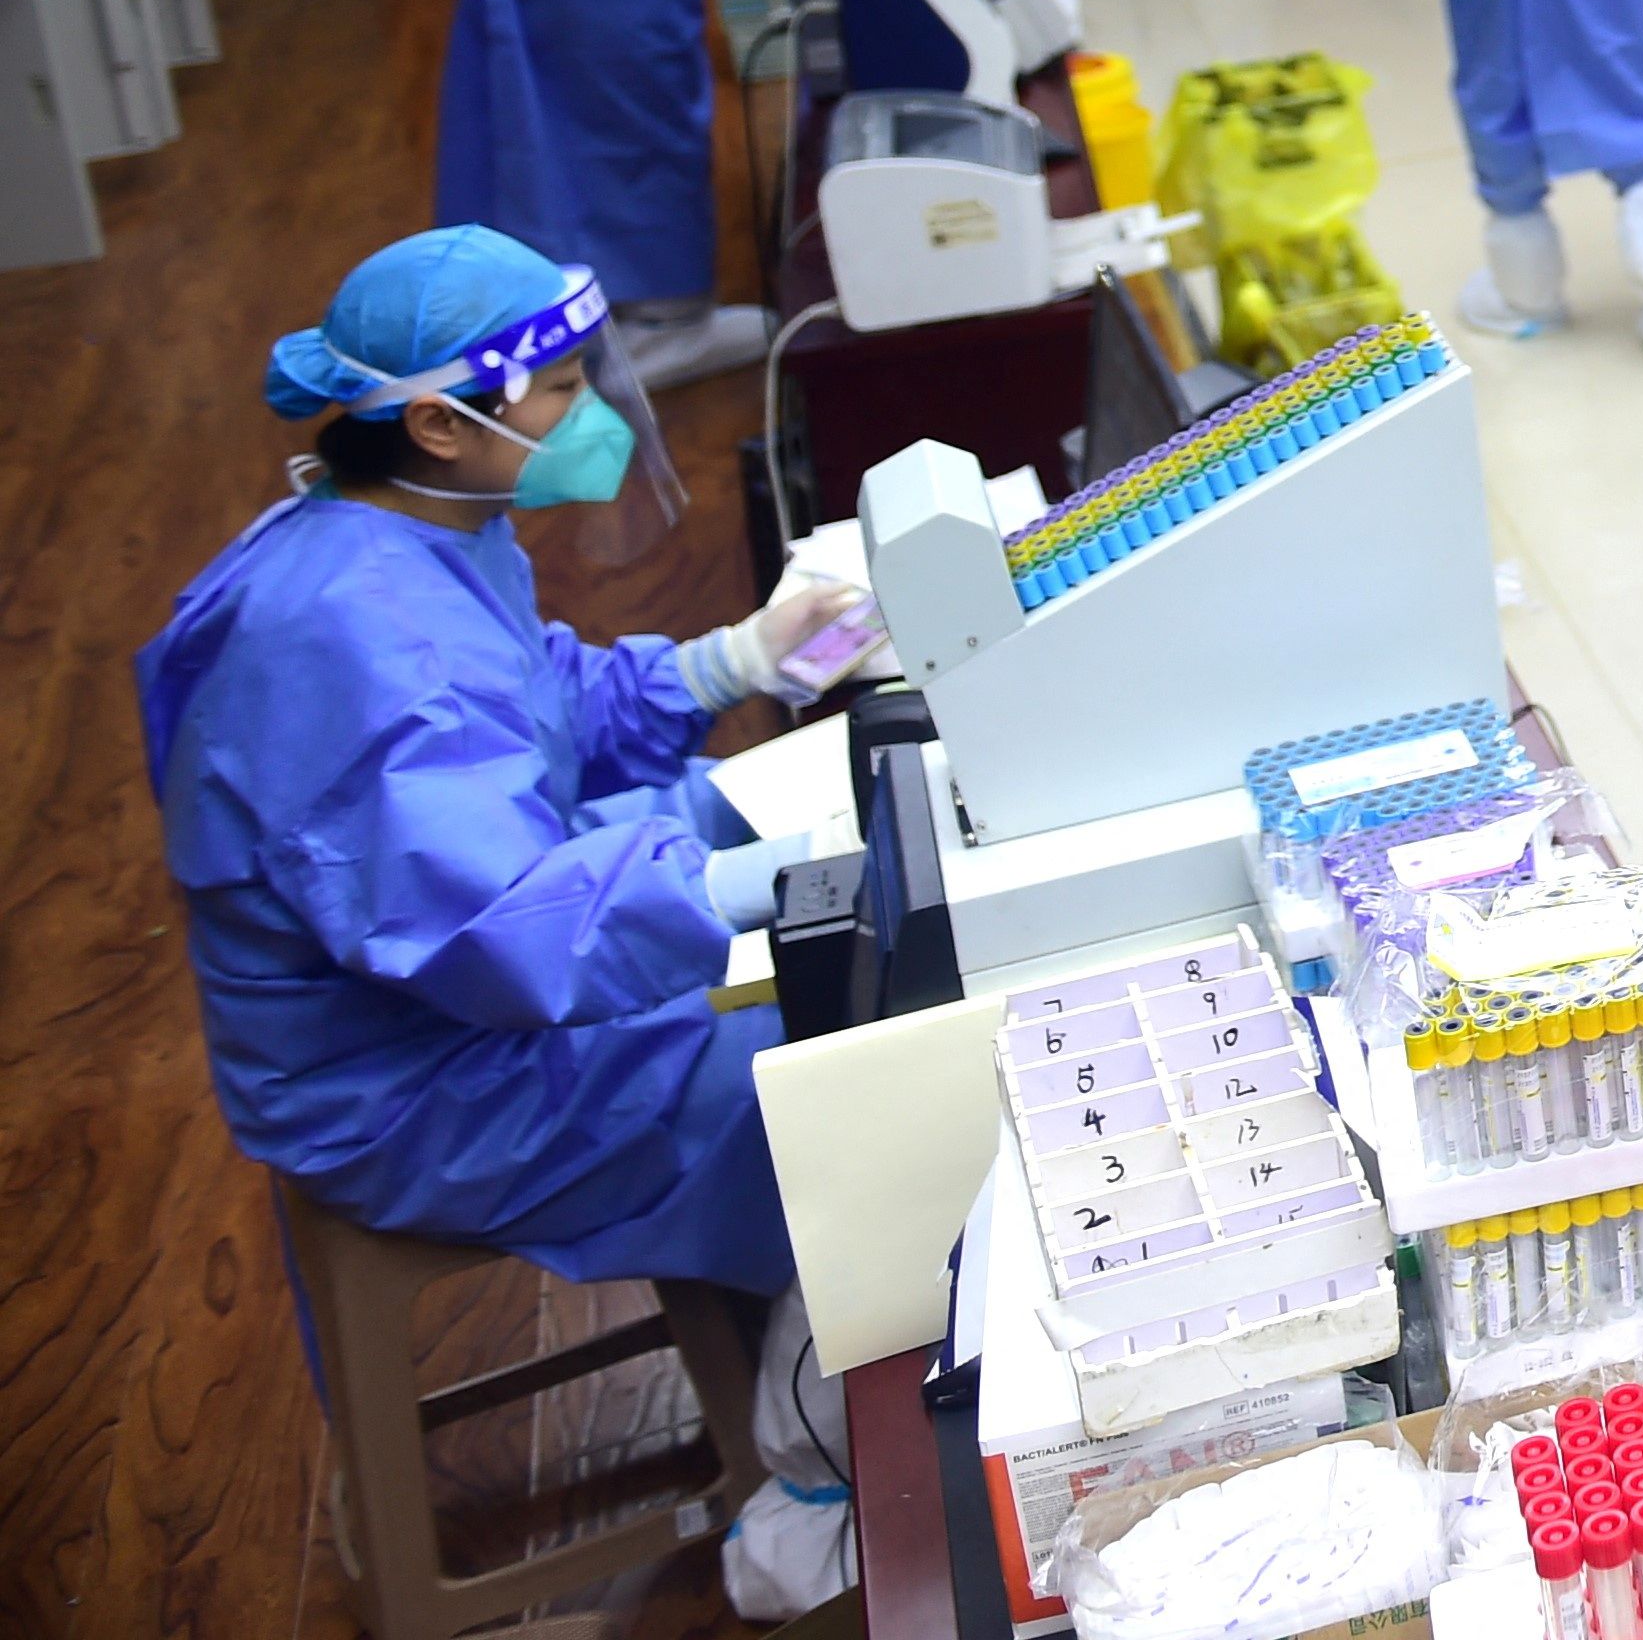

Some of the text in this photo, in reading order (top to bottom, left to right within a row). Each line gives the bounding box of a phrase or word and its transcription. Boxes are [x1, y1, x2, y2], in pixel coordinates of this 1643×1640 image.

[1184, 959, 1203, 983] 8
[1043, 998, 1063, 1013] 7
[1203, 991, 1217, 1015] 9
[1046, 1027, 1067, 1054] 6
[1212, 1027, 1239, 1054] 10
[1076, 1063, 1095, 1094] 5
[1224, 1078, 1258, 1100] 12
[1083, 1107, 1107, 1136] 4
[1237, 1118, 1260, 1145] 13
[1101, 1155, 1126, 1184] 3
[1249, 1162, 1283, 1187] 14
[1072, 1207, 1112, 1231] 2
